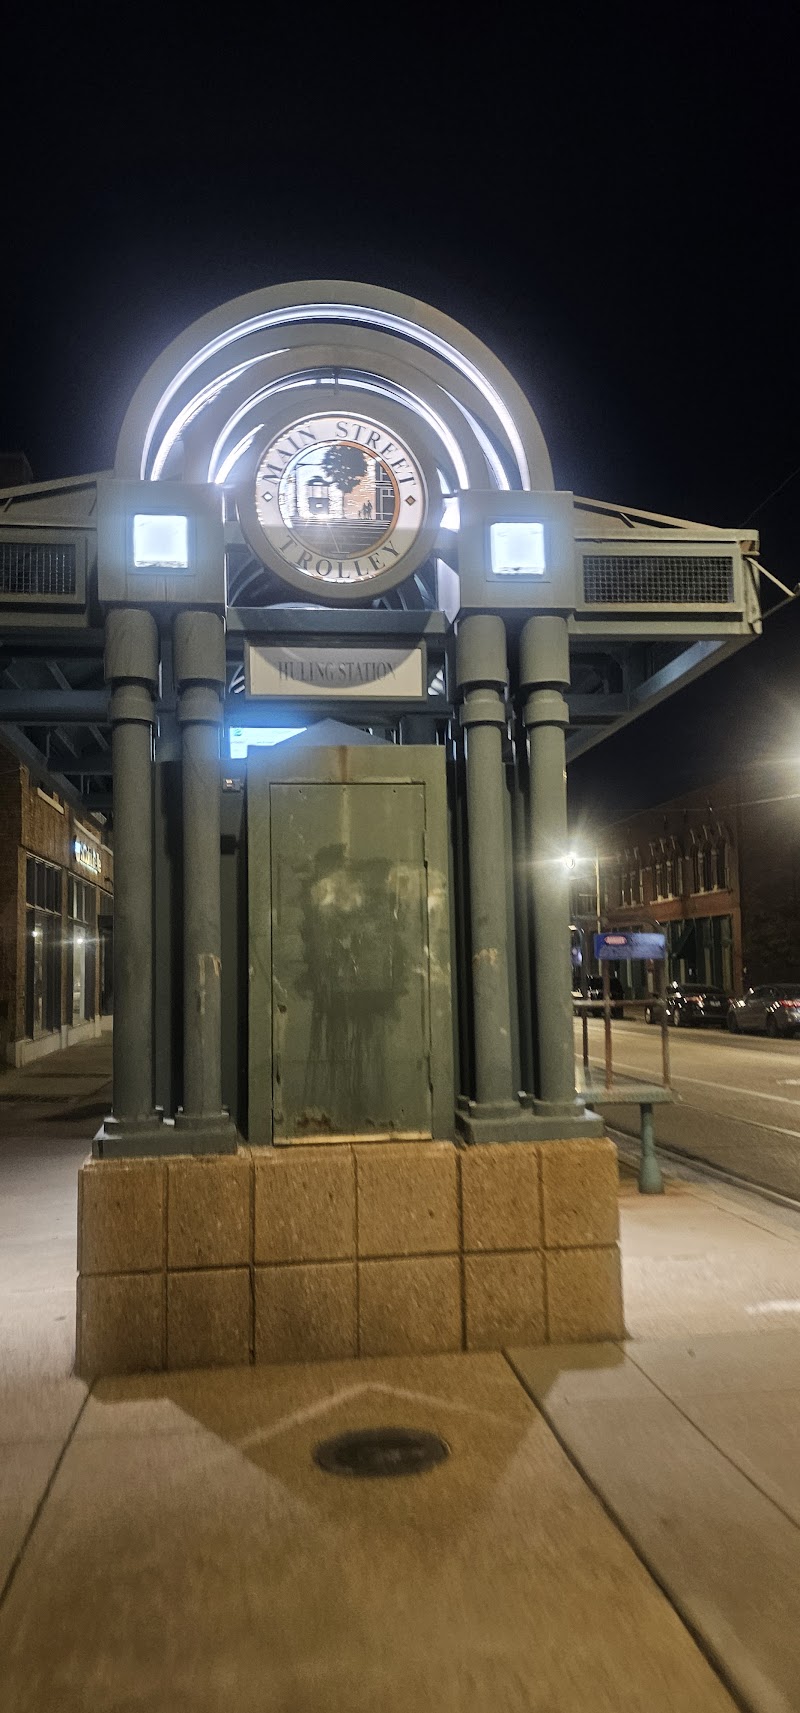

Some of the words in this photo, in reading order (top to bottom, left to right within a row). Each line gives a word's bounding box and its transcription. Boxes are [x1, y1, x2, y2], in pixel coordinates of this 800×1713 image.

[262, 426, 317, 485] MAIN
[335, 422, 416, 487] STREET
[278, 534, 400, 579] TROLLEY
[278, 661, 334, 682] HULING
[338, 661, 398, 682] STATION
